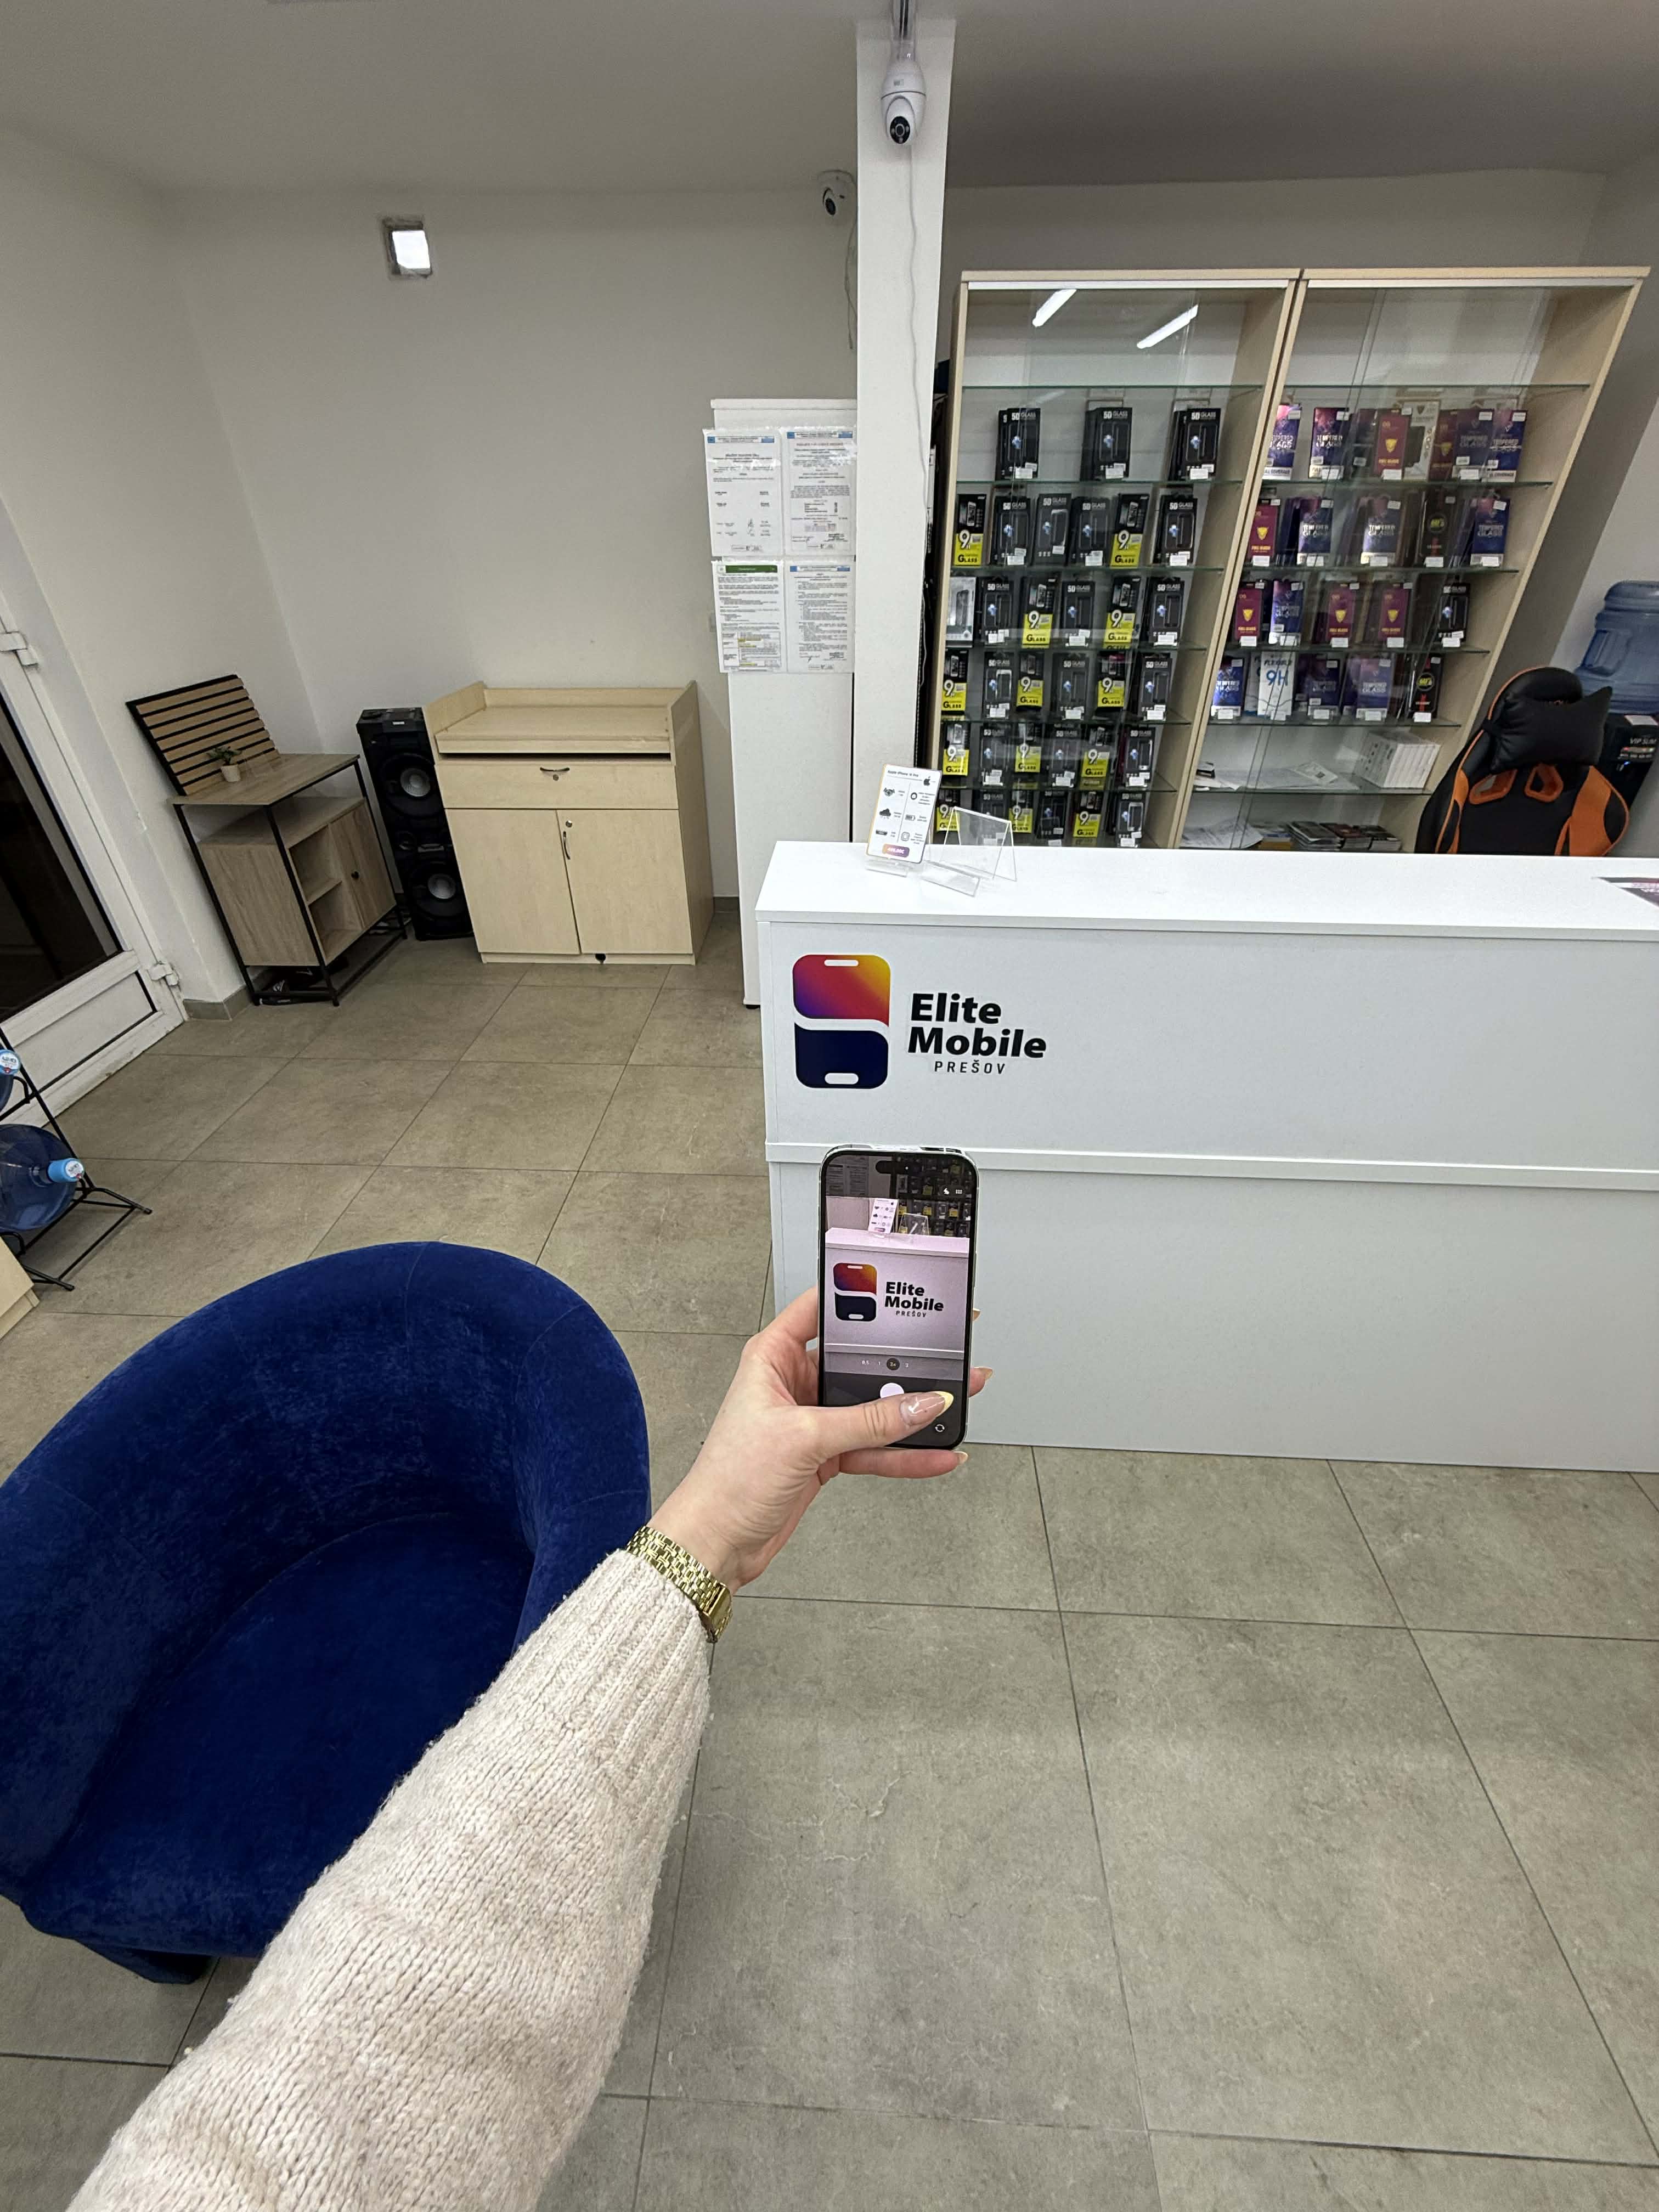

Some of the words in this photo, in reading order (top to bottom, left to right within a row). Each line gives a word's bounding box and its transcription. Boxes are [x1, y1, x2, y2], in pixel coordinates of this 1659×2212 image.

[1191, 412, 1200, 420] 5D
[1043, 498, 1051, 506] 5D
[957, 555, 978, 563] GLASS
[1115, 555, 1135, 563] GLASS
[1026, 634, 1046, 642] GLASS
[1108, 633, 1127, 641] GLASS
[1266, 670, 1289, 686] 9H
[911, 992, 1001, 1024] Elite
[908, 1026, 1046, 1058] Mobile
[934, 1059, 1006, 1074] PREŠOV
[885, 1282, 924, 1296] Elite
[884, 1296, 944, 1311] Mobile
